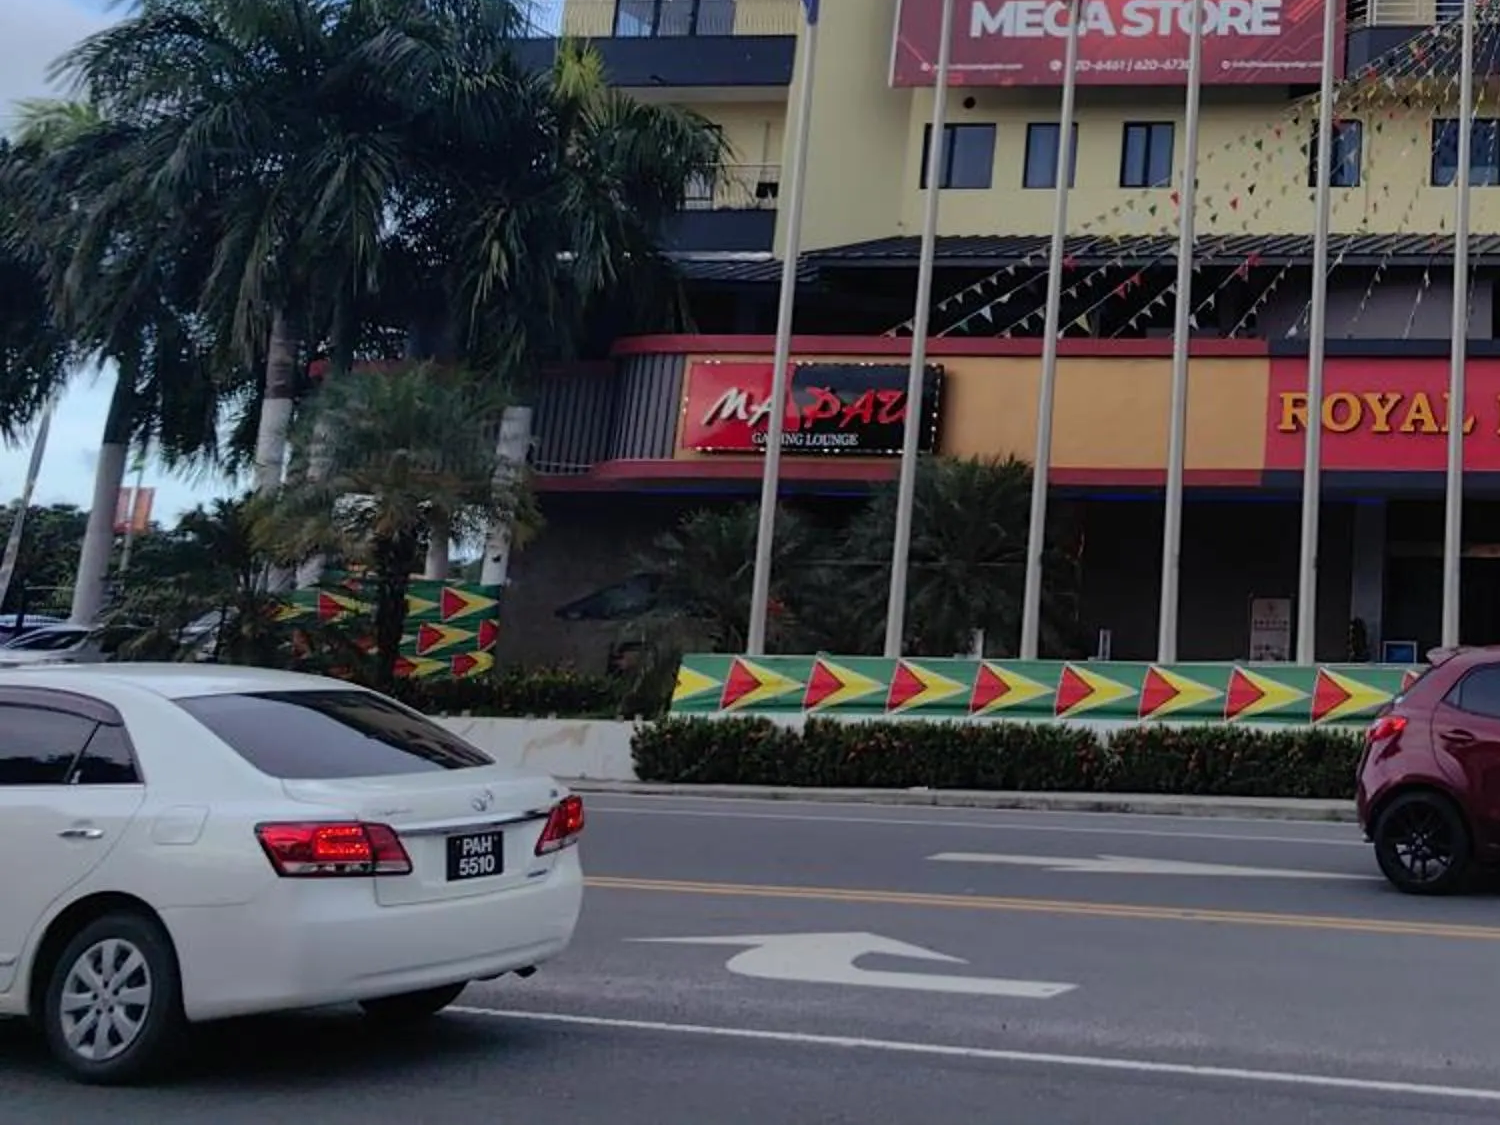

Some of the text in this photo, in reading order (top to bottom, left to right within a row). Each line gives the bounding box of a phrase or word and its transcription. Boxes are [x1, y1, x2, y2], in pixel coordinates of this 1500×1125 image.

[1277, 392, 1477, 433] ROYAL
[752, 433, 859, 446] GAING LOUNGE
[463, 835, 492, 855] PAH
[459, 856, 495, 875] 5510
